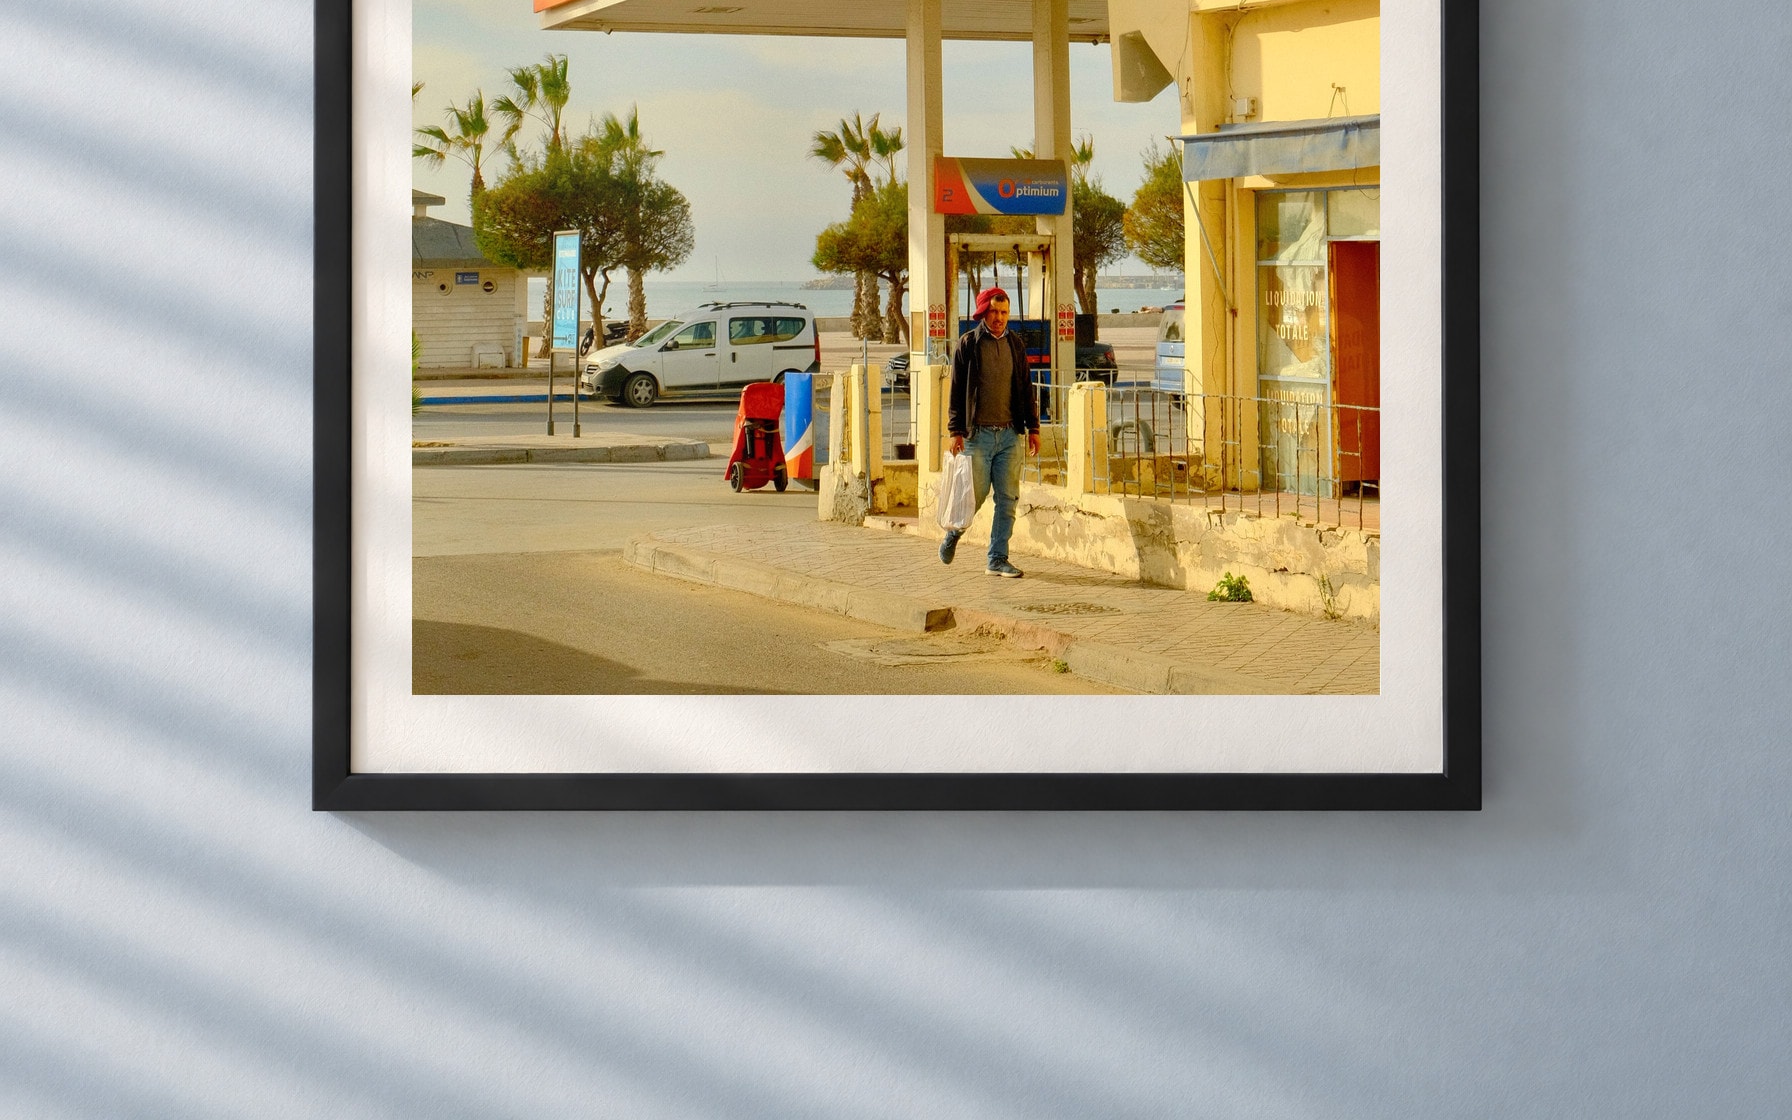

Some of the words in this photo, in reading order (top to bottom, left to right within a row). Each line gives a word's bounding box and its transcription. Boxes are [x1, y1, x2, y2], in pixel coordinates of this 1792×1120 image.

[942, 189, 954, 202] 2
[997, 178, 1059, 198] Optimium
[558, 268, 576, 288] KITE
[558, 289, 576, 309] SURF
[1265, 290, 1322, 307] LIQUIDATION
[1275, 324, 1308, 340] TOTALE
